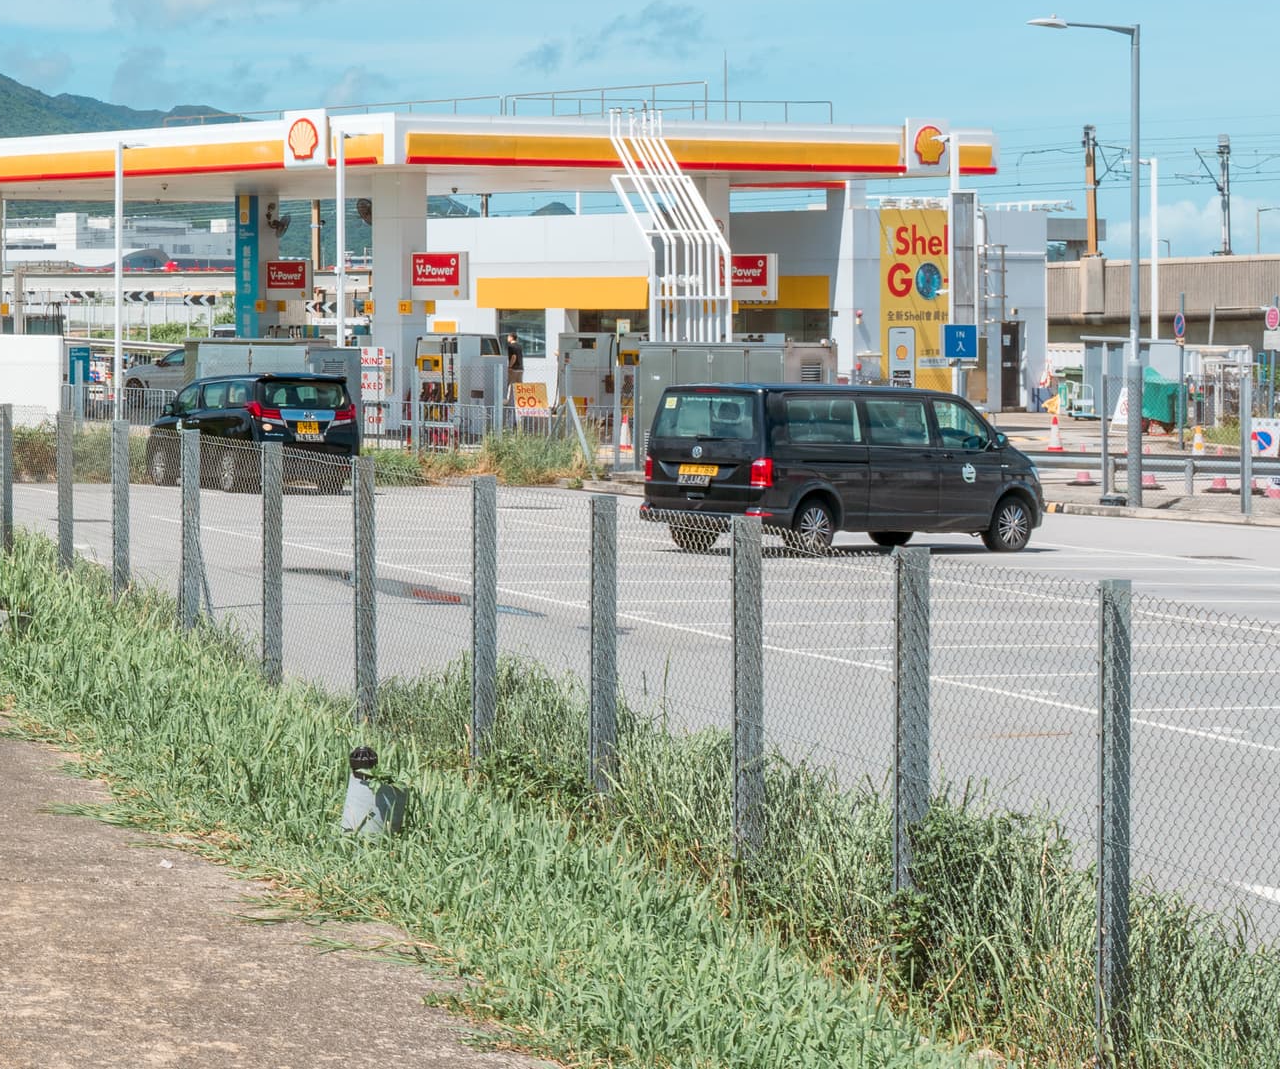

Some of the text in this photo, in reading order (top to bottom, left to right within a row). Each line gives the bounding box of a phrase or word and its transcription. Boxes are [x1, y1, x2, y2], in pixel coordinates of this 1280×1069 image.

[895, 224, 949, 256] Shel
[416, 265, 455, 276] V-Power
[270, 272, 301, 281] V-Power
[887, 310, 949, 322] 全新Shell會員計
[956, 341, 966, 352] 入
[360, 382, 383, 390] AKED
[516, 385, 535, 393] Shell
